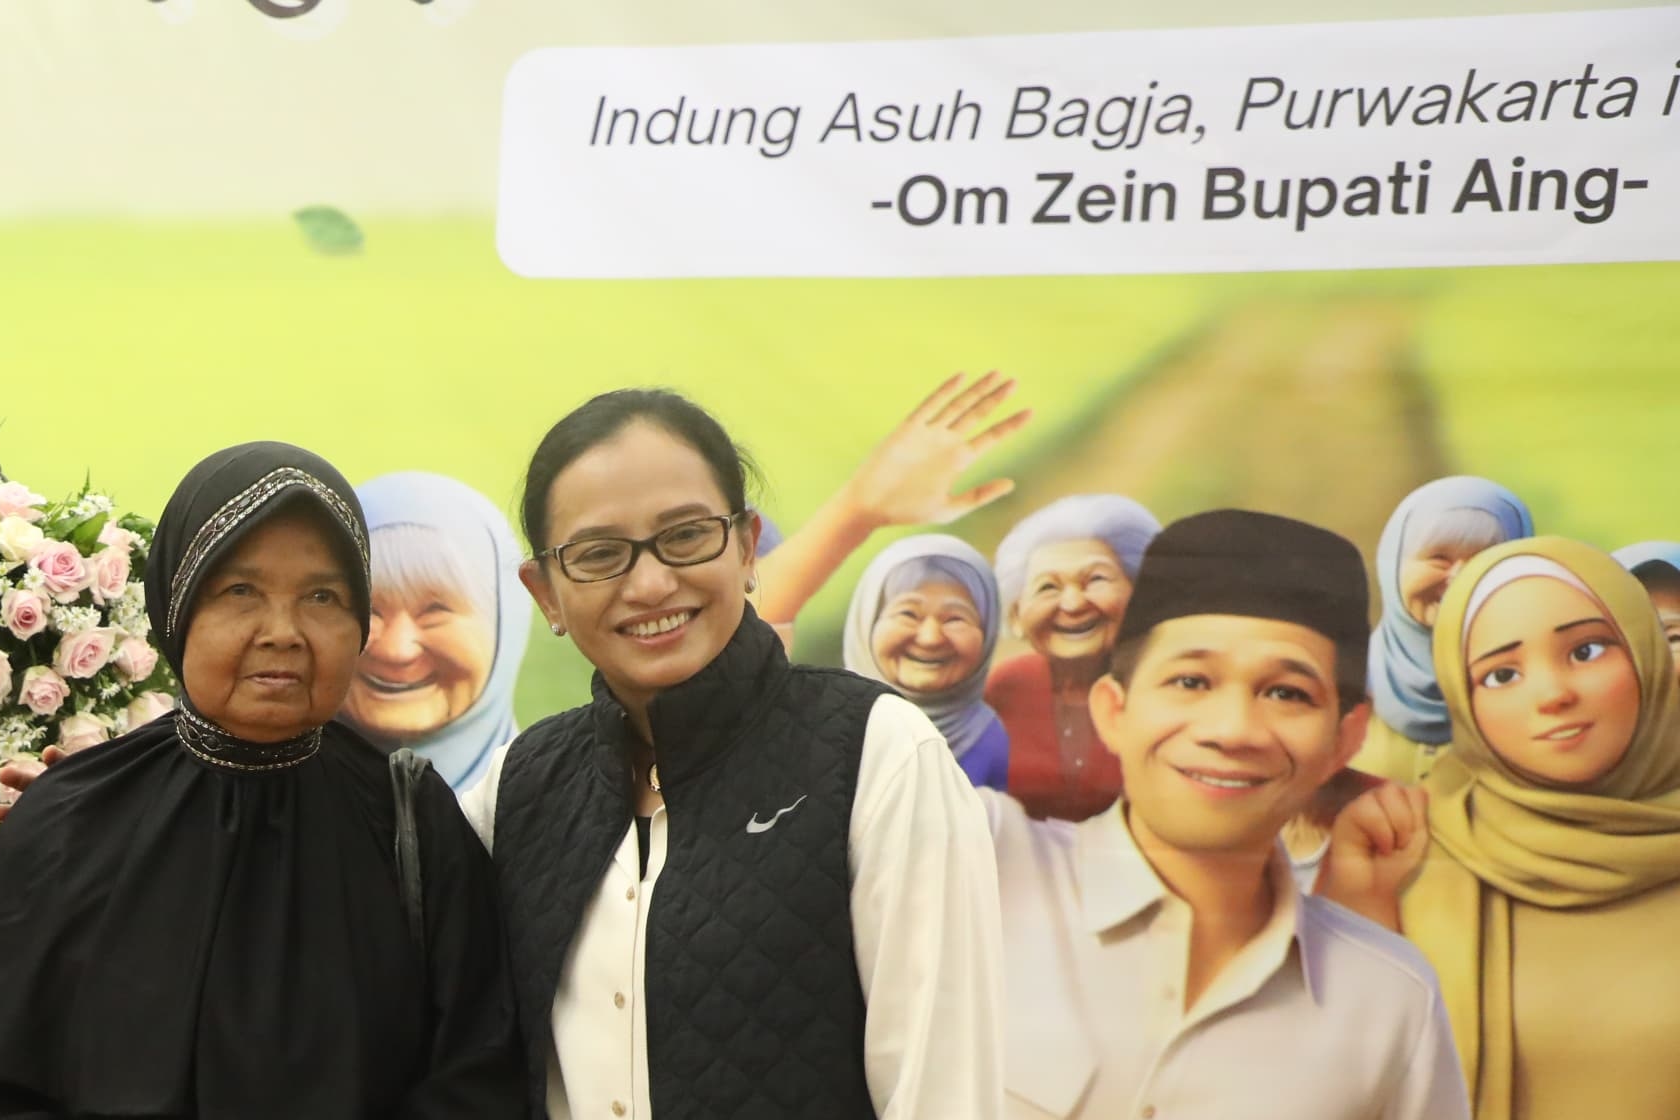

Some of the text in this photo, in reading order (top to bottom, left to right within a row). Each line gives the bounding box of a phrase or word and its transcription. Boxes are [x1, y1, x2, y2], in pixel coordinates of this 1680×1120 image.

[589, 95, 801, 159] Indung
[819, 89, 982, 143] Asuh
[1005, 80, 1206, 151] Bagja,
[1235, 62, 1639, 132] Purwakarta
[871, 155, 1649, 232] -Om Zein Bupati Aing-
